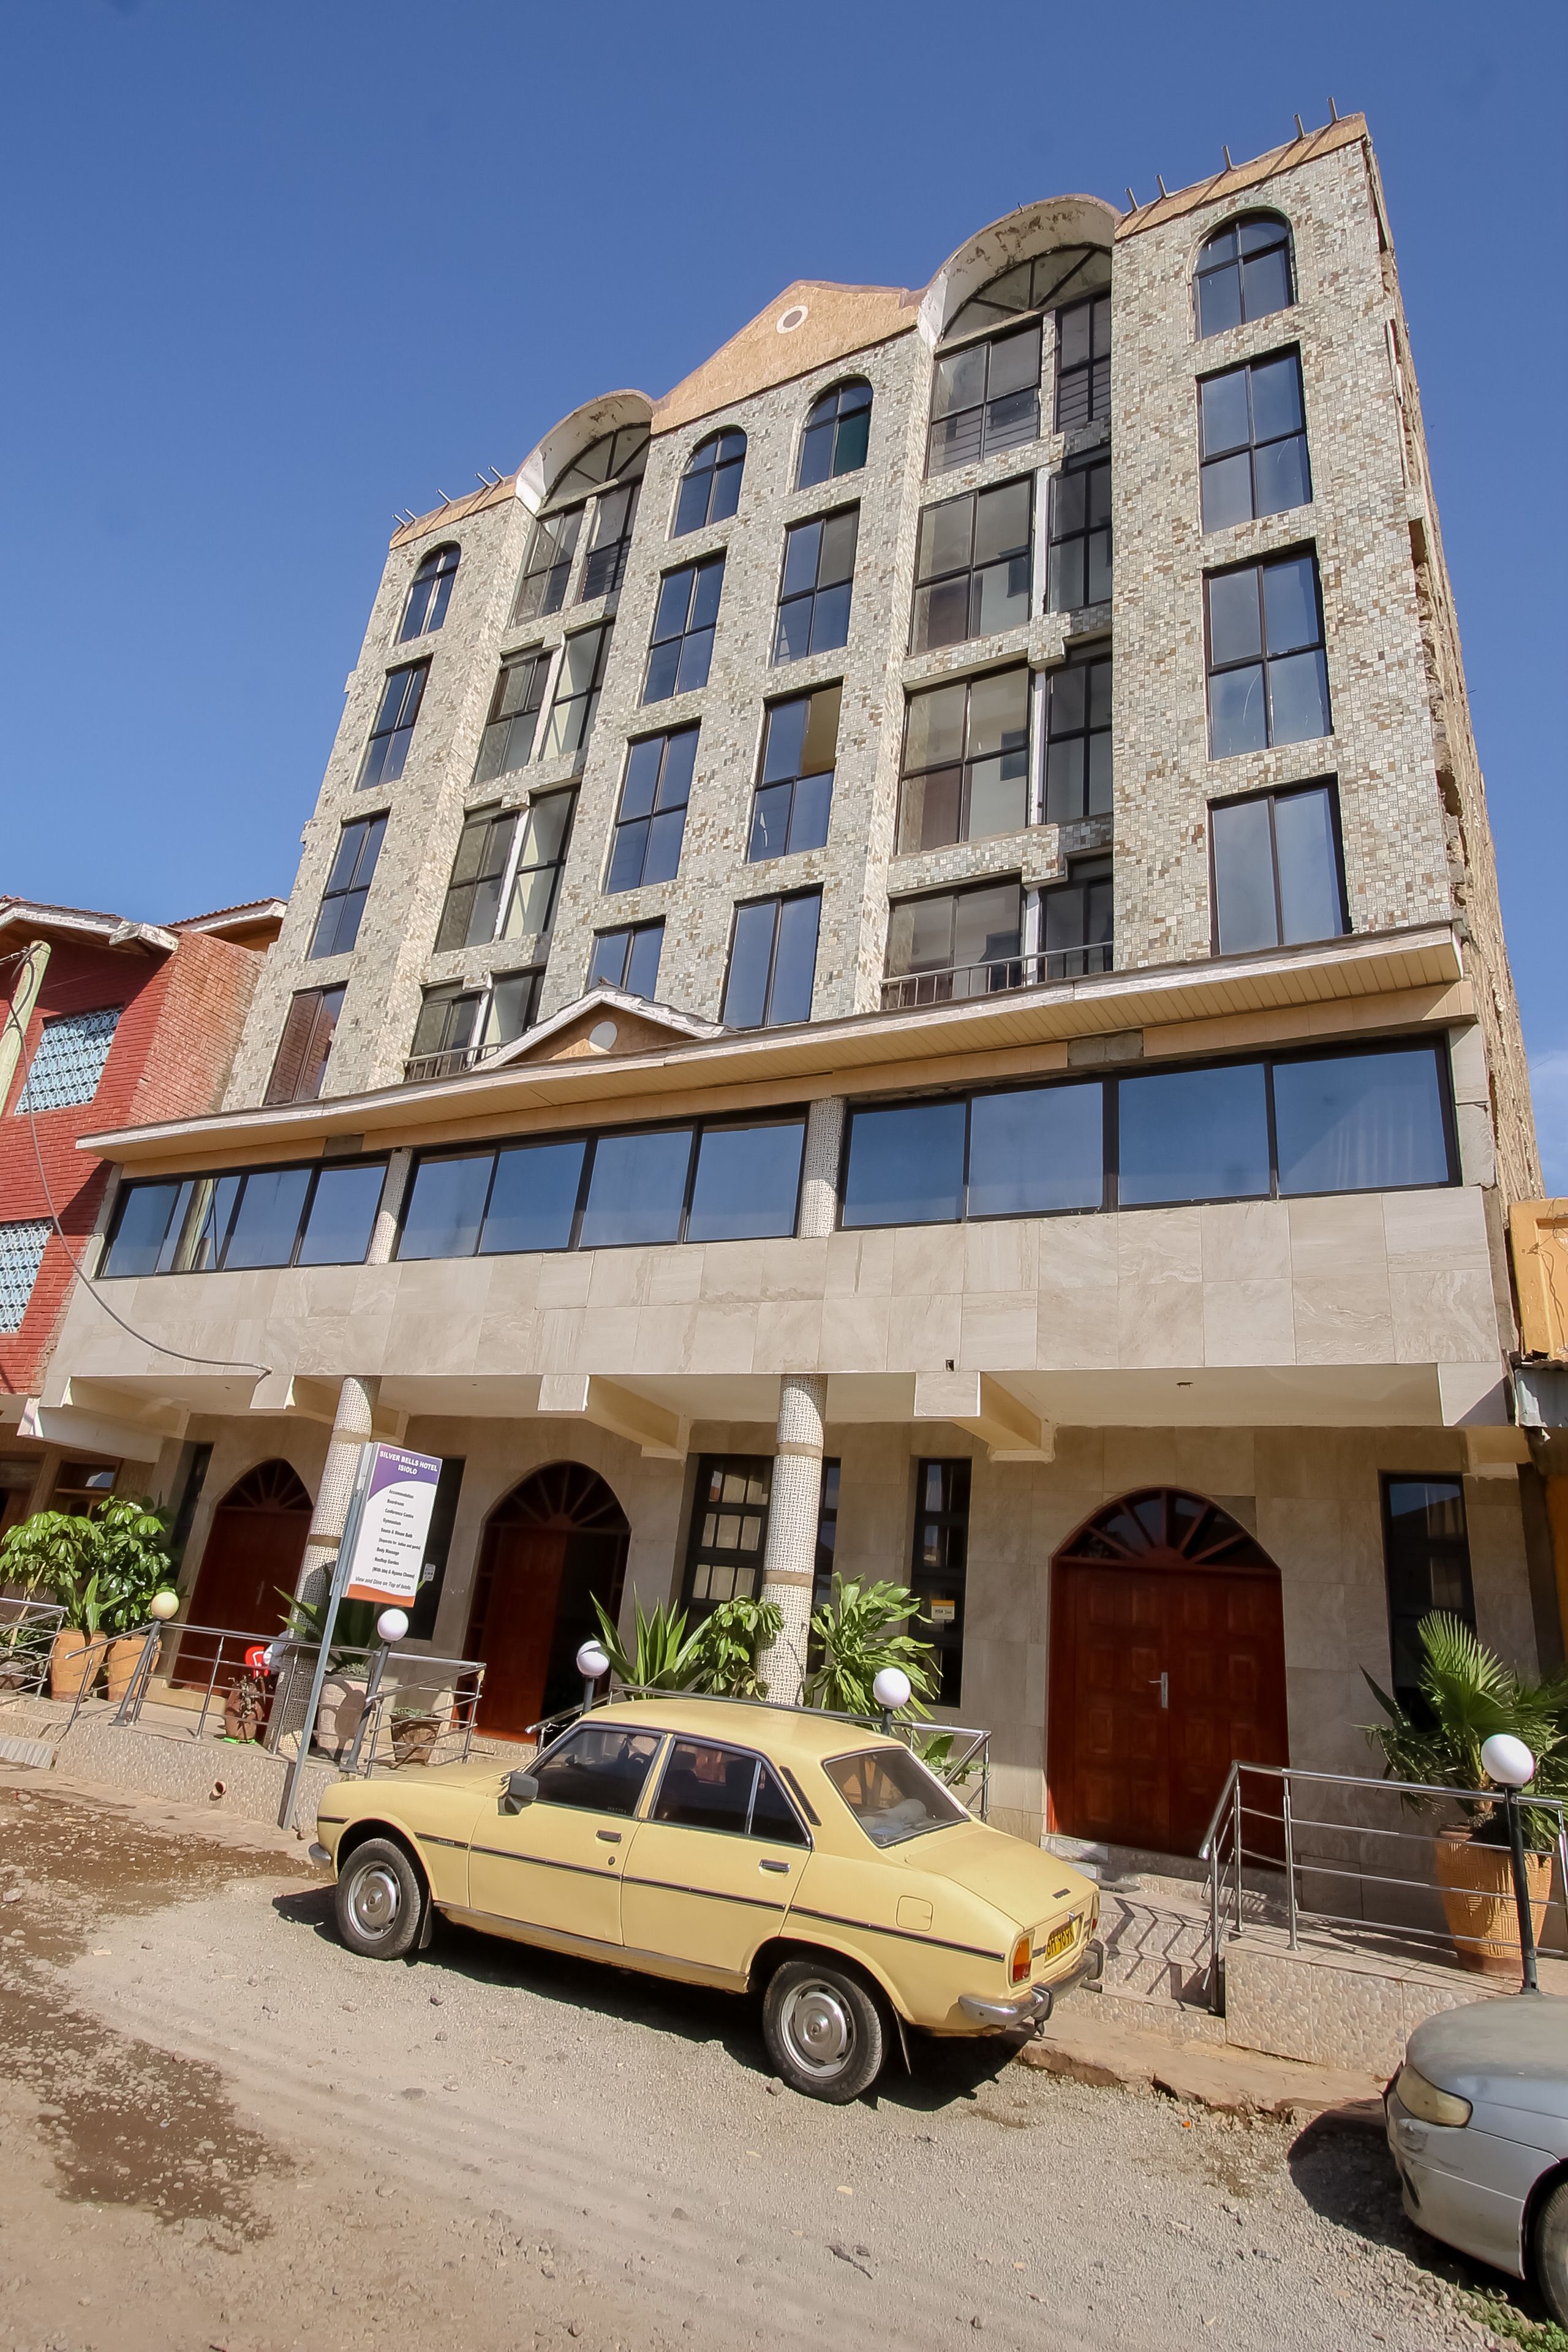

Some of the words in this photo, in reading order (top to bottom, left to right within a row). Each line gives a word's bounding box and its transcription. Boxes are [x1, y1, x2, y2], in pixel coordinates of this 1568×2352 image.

[380, 1450, 400, 1462] SILVER
[401, 1456, 419, 1466] BELLS
[420, 1461, 437, 1472] HOTEL
[398, 1464, 417, 1475] ISIOLO
